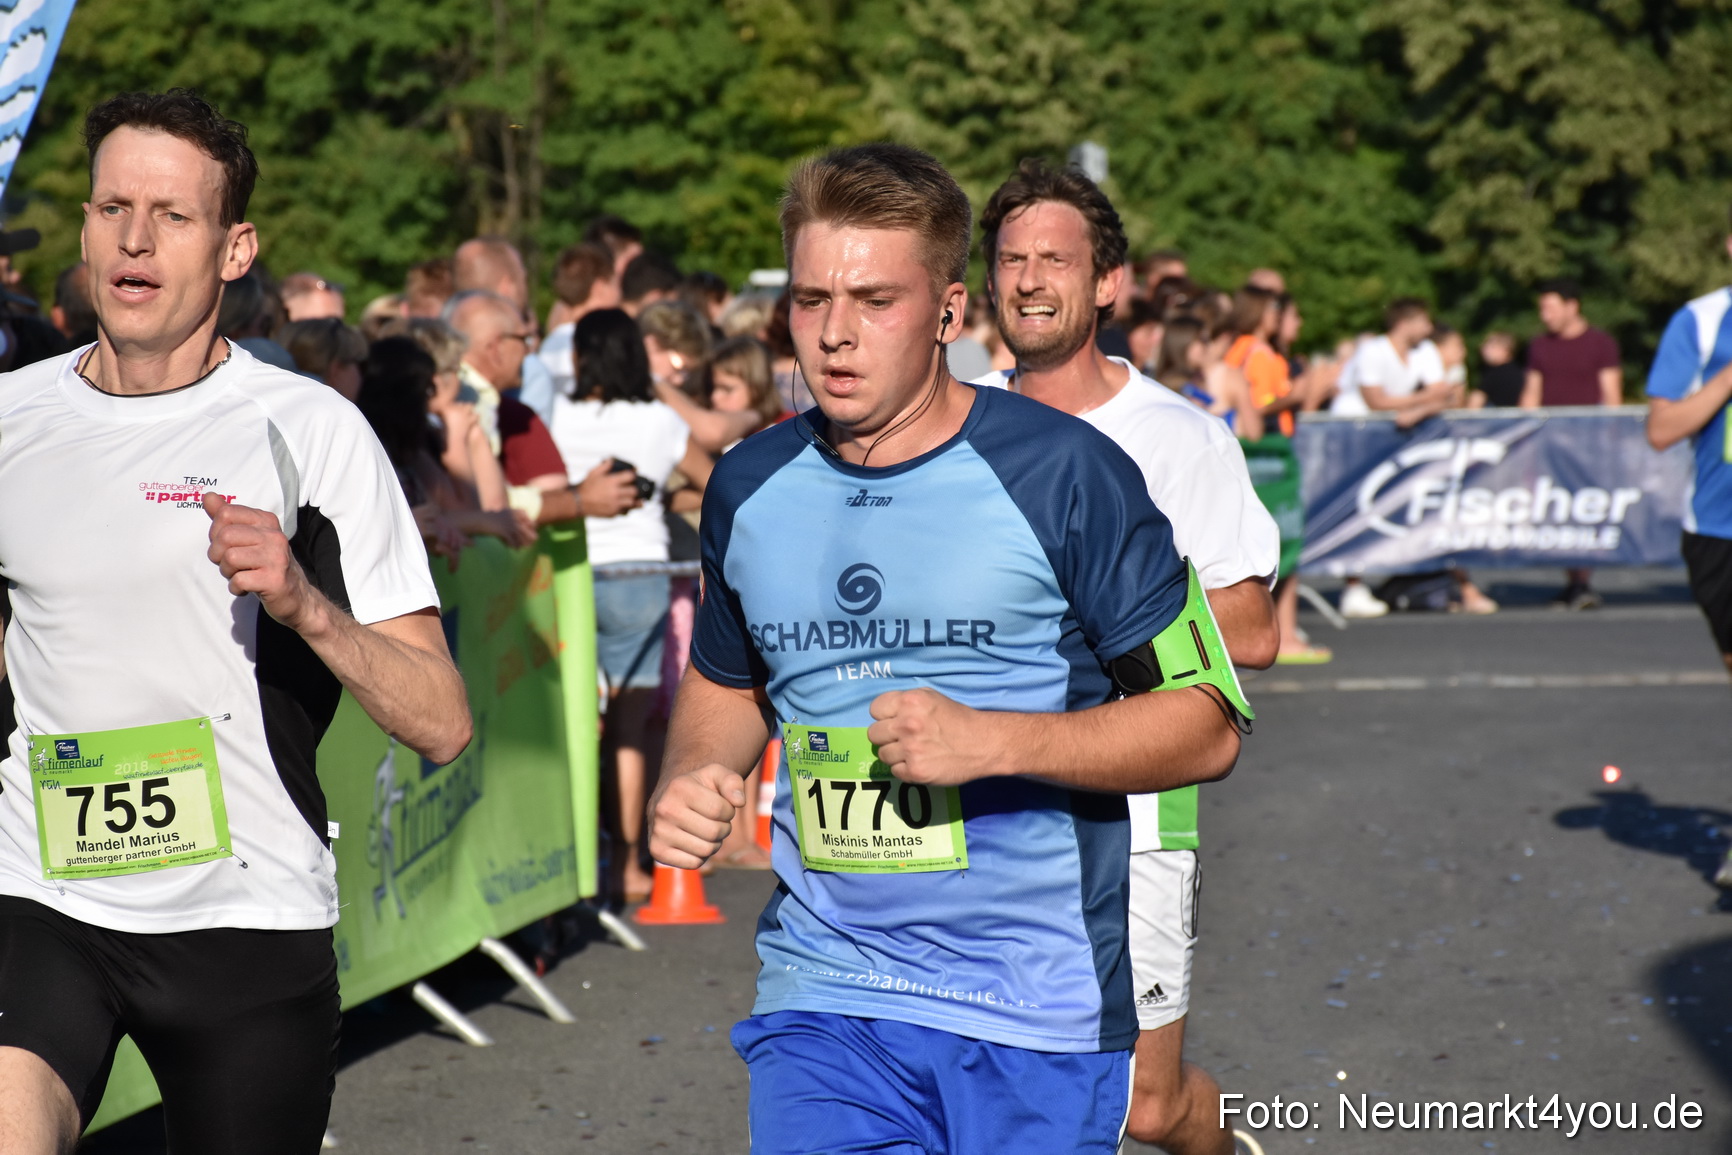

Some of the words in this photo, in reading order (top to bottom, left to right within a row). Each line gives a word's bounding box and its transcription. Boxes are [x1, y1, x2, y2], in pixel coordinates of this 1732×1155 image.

[139, 482, 205, 492] guttenberger
[184, 476, 217, 486] TEAM
[157, 491, 236, 504] partr
[1406, 474, 1642, 525] Fischer
[1431, 526, 1621, 550] AUTOMOBILE
[750, 619, 997, 653] SCHABMÜLLER
[832, 661, 895, 681] TEAM
[48, 754, 104, 769] firmenlauf
[802, 748, 850, 762] firmenlauf
[115, 761, 149, 775] 2018
[65, 777, 176, 836] 755
[808, 779, 932, 830] 1770
[76, 837, 125, 853] Mandel
[130, 831, 180, 848] Marius
[821, 833, 869, 847] Miskinis
[872, 834, 923, 847] Mantas
[65, 852, 123, 866] guttenberger
[125, 848, 161, 862] partner
[164, 841, 196, 855] GmbH
[831, 849, 881, 859] Schabmüller
[883, 849, 913, 859] GmbH
